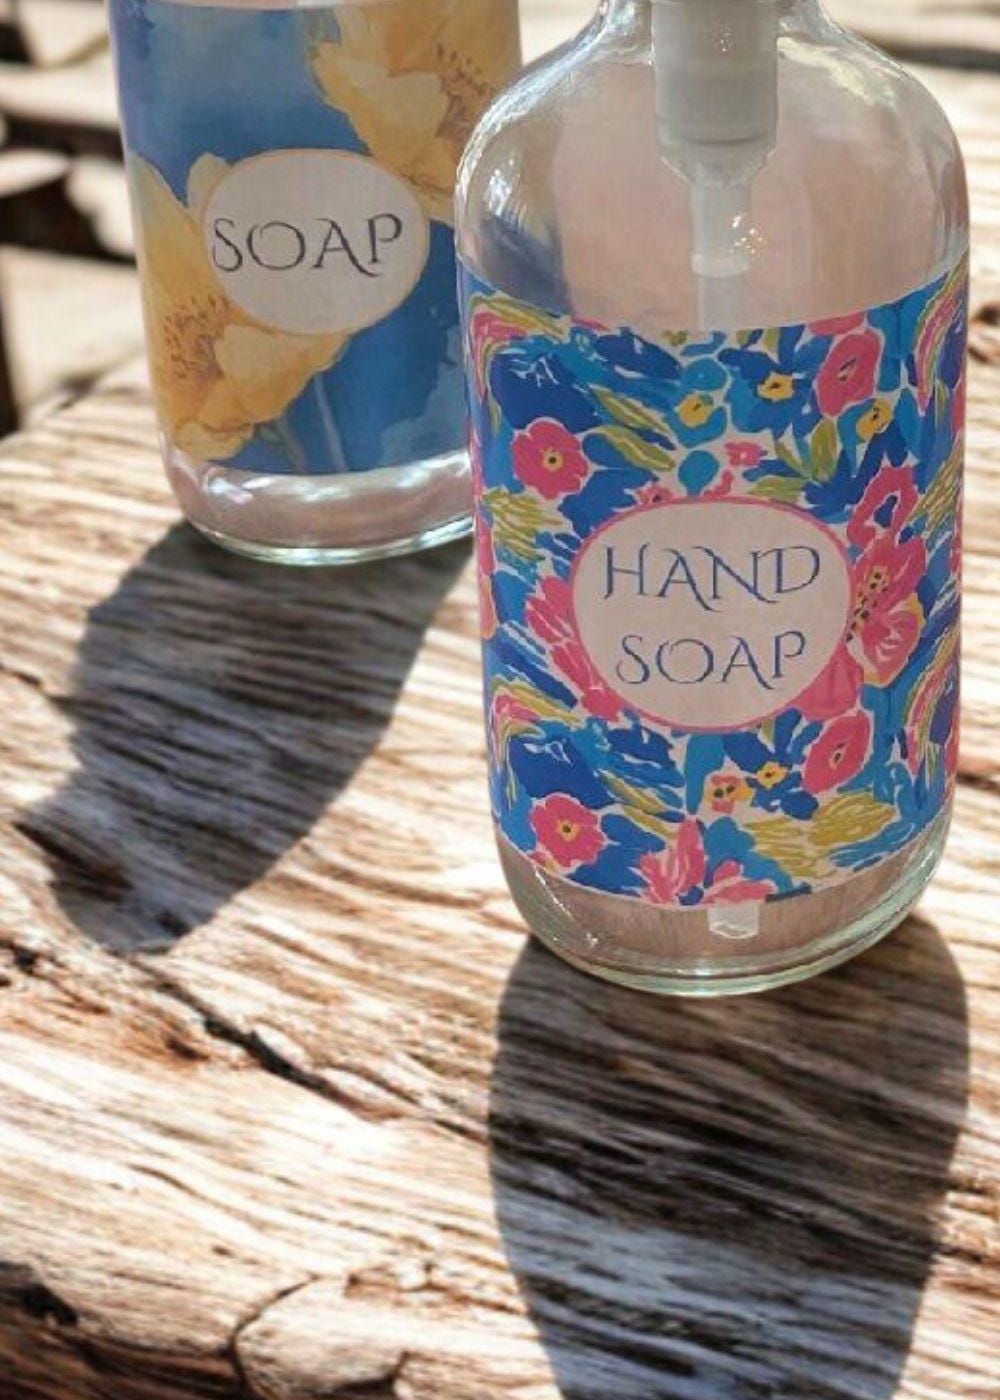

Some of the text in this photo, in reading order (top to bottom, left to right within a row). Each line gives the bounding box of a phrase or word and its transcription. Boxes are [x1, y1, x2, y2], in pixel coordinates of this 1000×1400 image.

[211, 212, 404, 278] SOAP
[603, 541, 821, 613] HAND
[614, 629, 808, 691] SOAP
